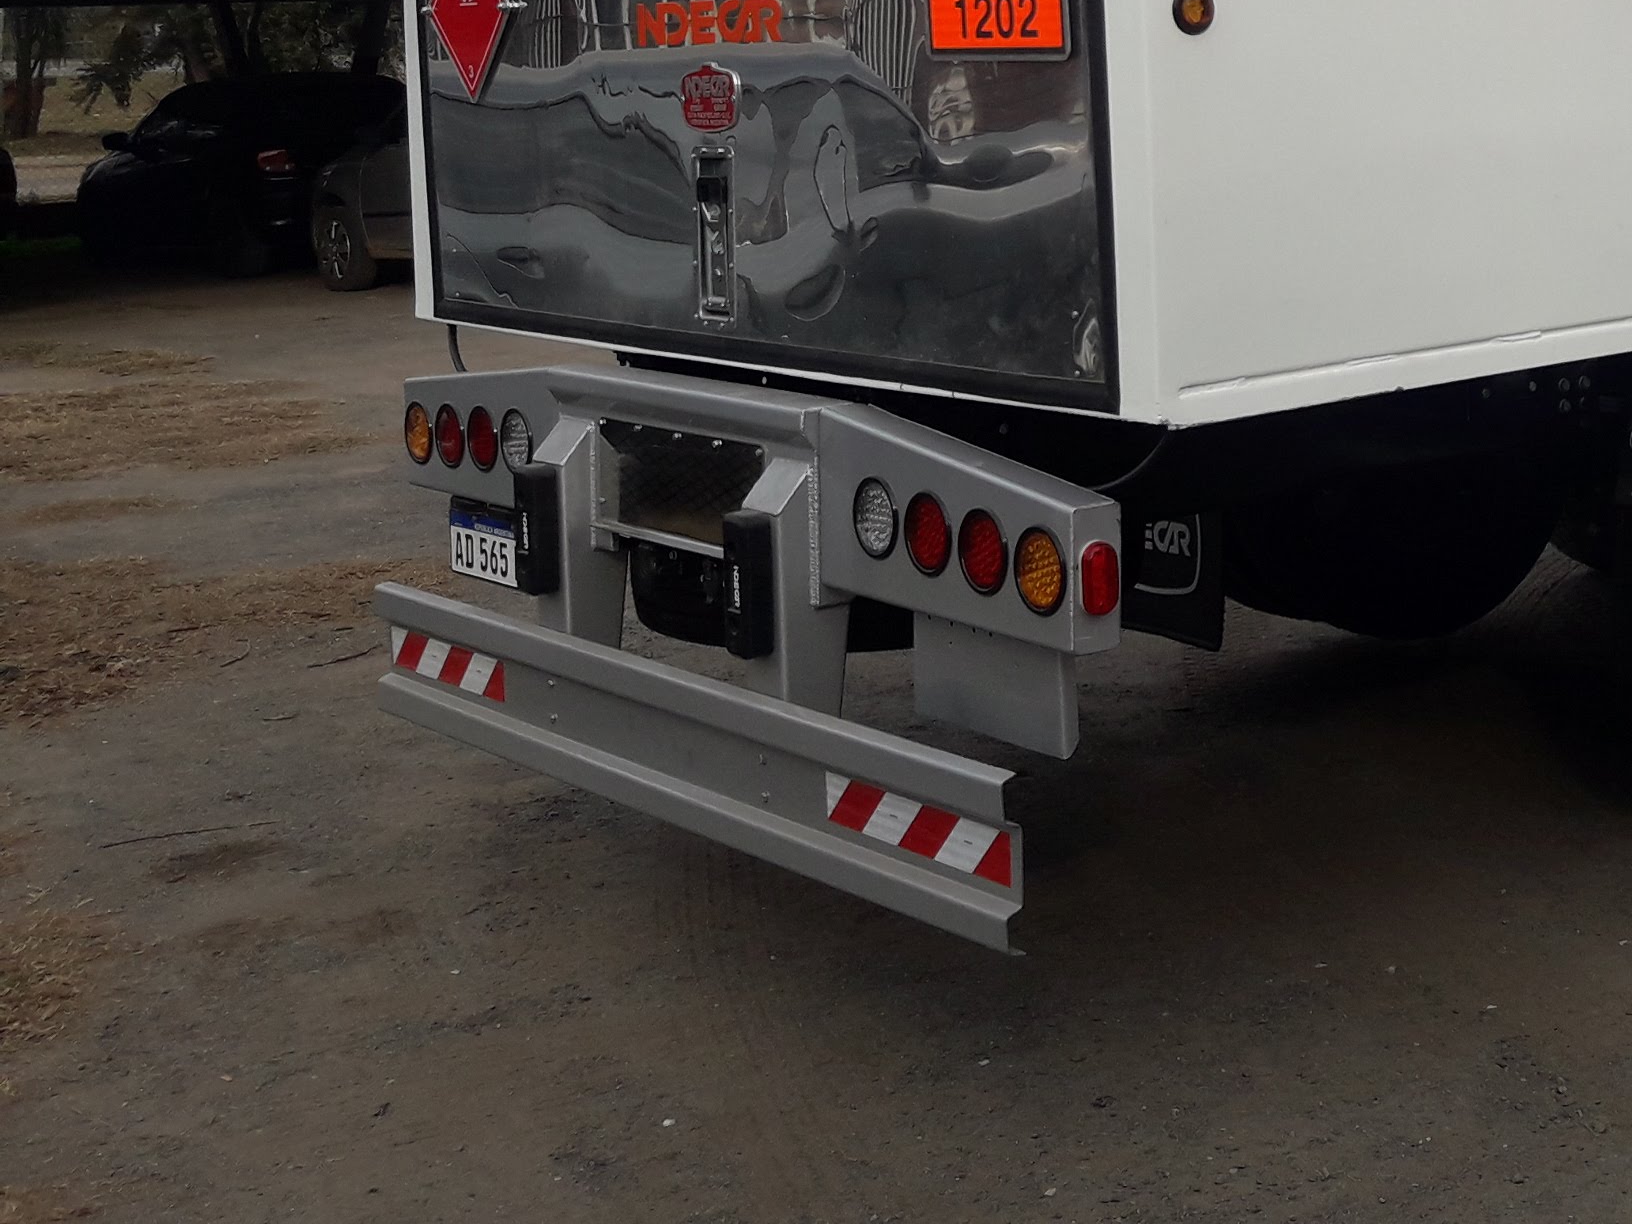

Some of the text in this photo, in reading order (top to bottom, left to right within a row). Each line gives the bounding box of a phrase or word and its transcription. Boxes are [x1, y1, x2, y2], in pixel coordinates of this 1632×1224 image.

[467, 65, 474, 79] 3
[455, 532, 509, 577] AD 565
